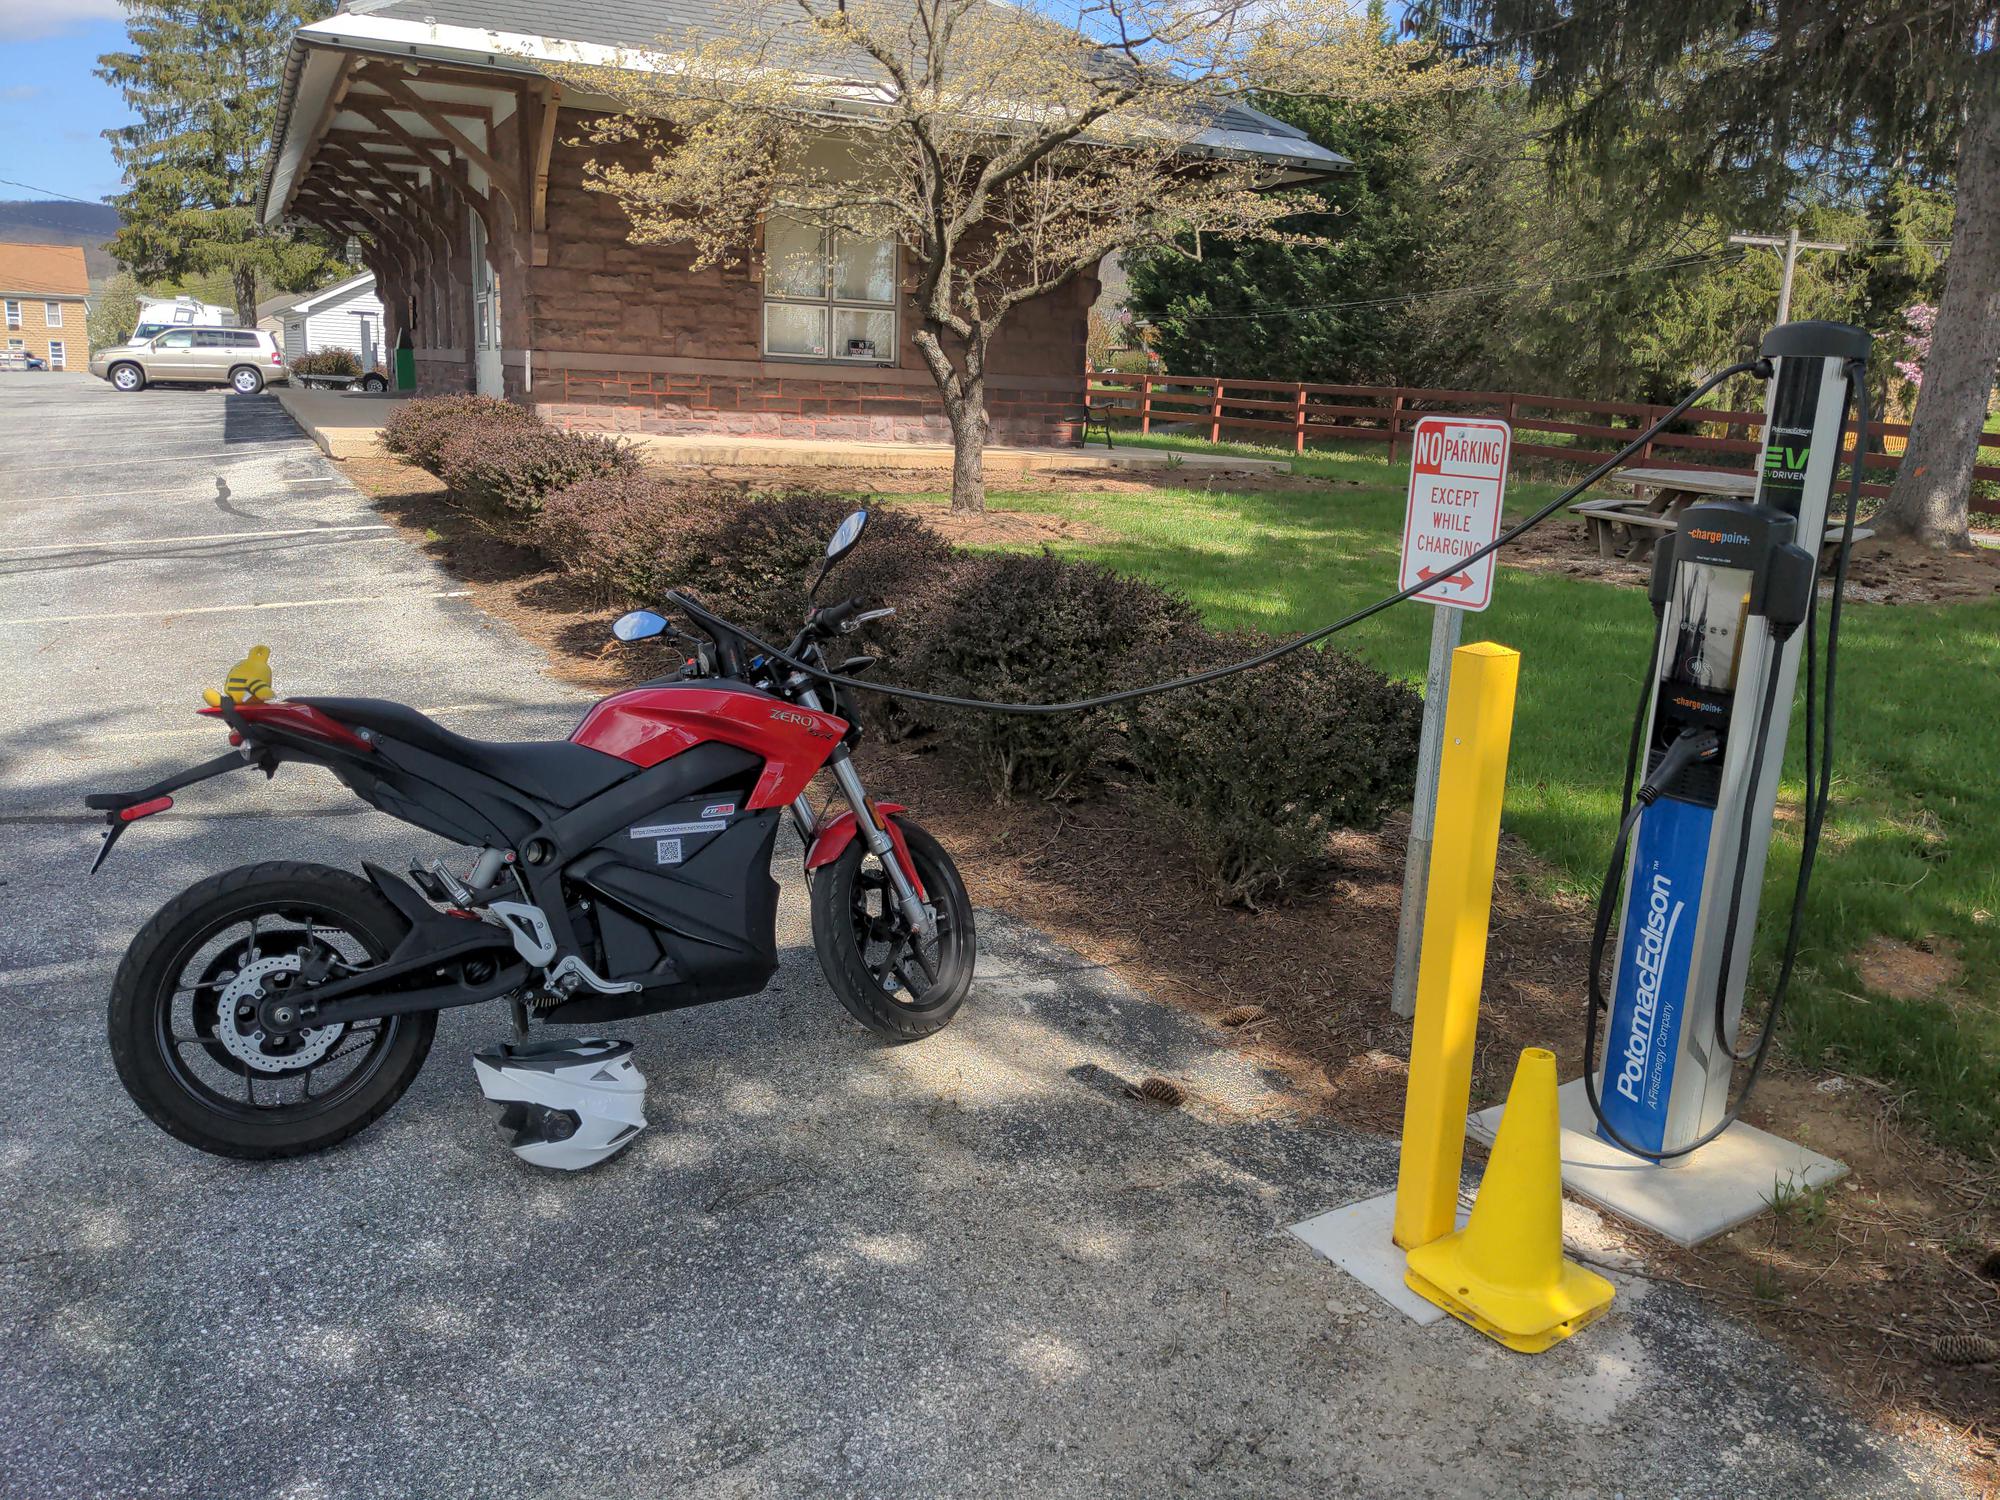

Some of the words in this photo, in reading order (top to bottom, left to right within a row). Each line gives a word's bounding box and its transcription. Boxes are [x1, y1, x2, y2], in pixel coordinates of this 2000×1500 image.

[1417, 431, 1442, 466] NO
[1444, 439, 1500, 465] PARKING
[1764, 447, 1810, 470] EV
[1431, 487, 1480, 508] EXCEPT
[1433, 511, 1472, 532] WHILE
[768, 708, 812, 727] ZERO
[1617, 874, 1671, 1103] PotomacEdison
[1656, 1001, 1674, 1048] Company
[1648, 1048, 1667, 1100] FirstEnergy
[1647, 1100, 1657, 1110] A
